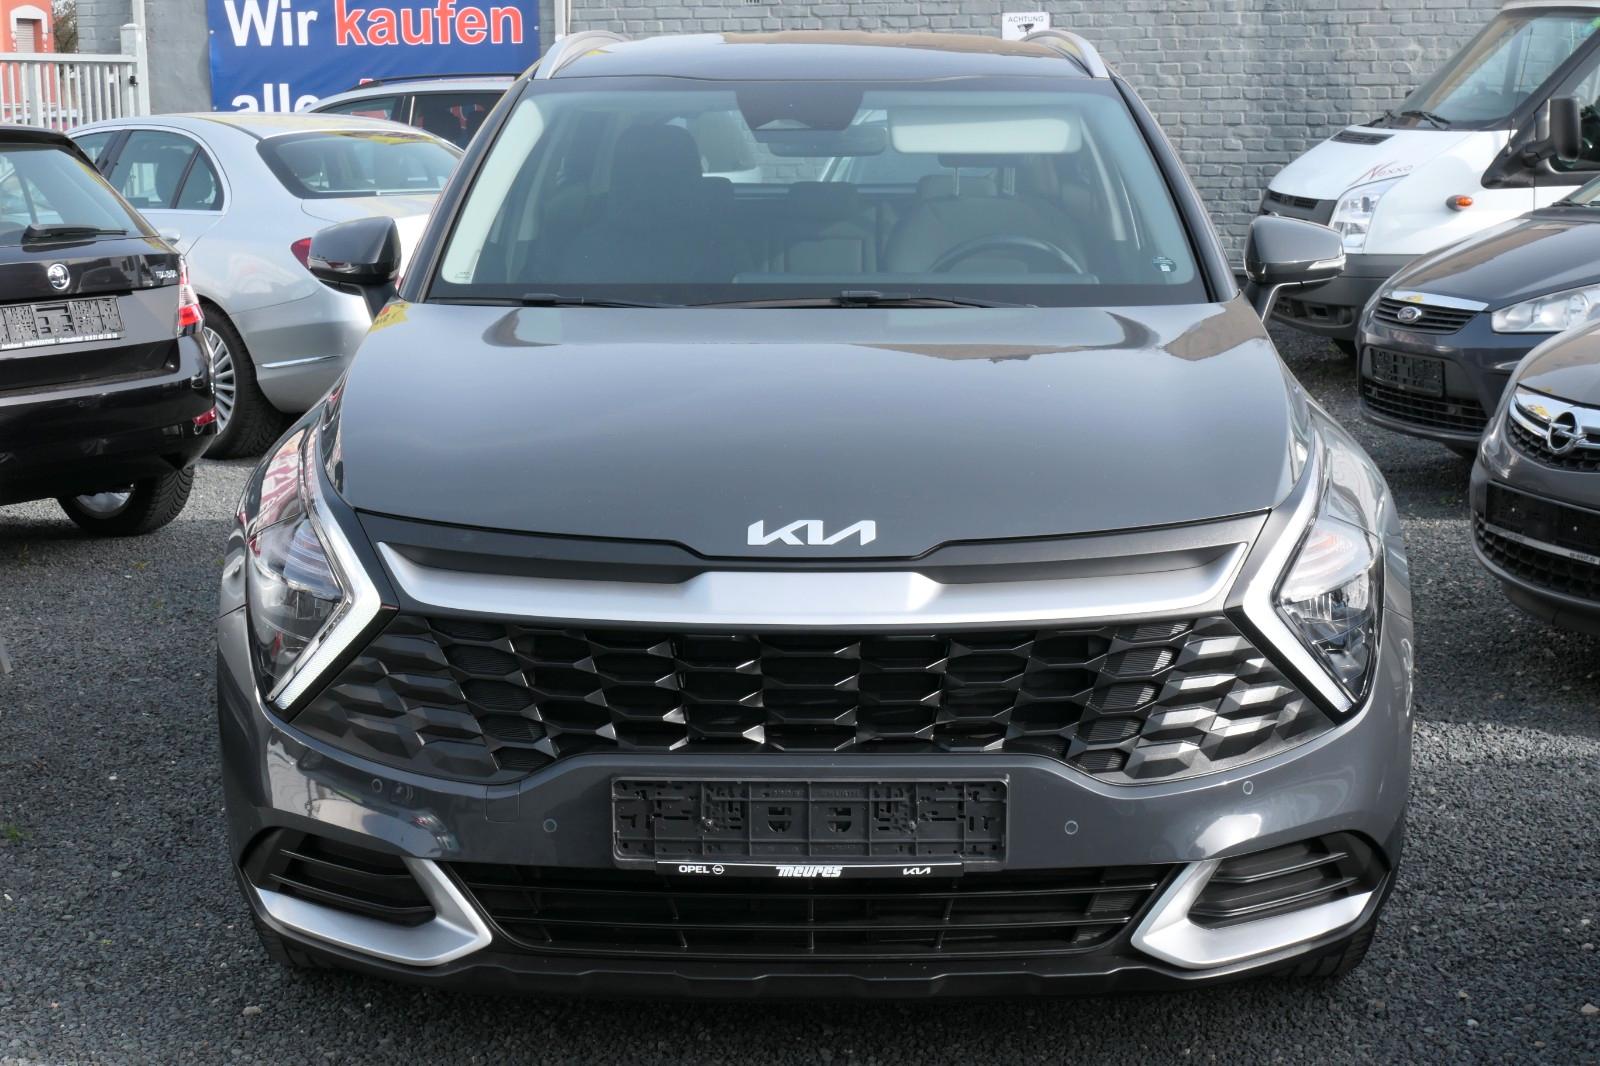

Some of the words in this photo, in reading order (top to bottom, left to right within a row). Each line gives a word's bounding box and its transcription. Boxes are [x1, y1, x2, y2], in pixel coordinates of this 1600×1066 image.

[223, 0, 318, 47] Wir
[334, 0, 524, 46] kaufen
[1007, 15, 1044, 23] ACHTUNG
[747, 519, 877, 546] KIA
[678, 864, 710, 874] OPEL
[902, 866, 931, 876] KIA
